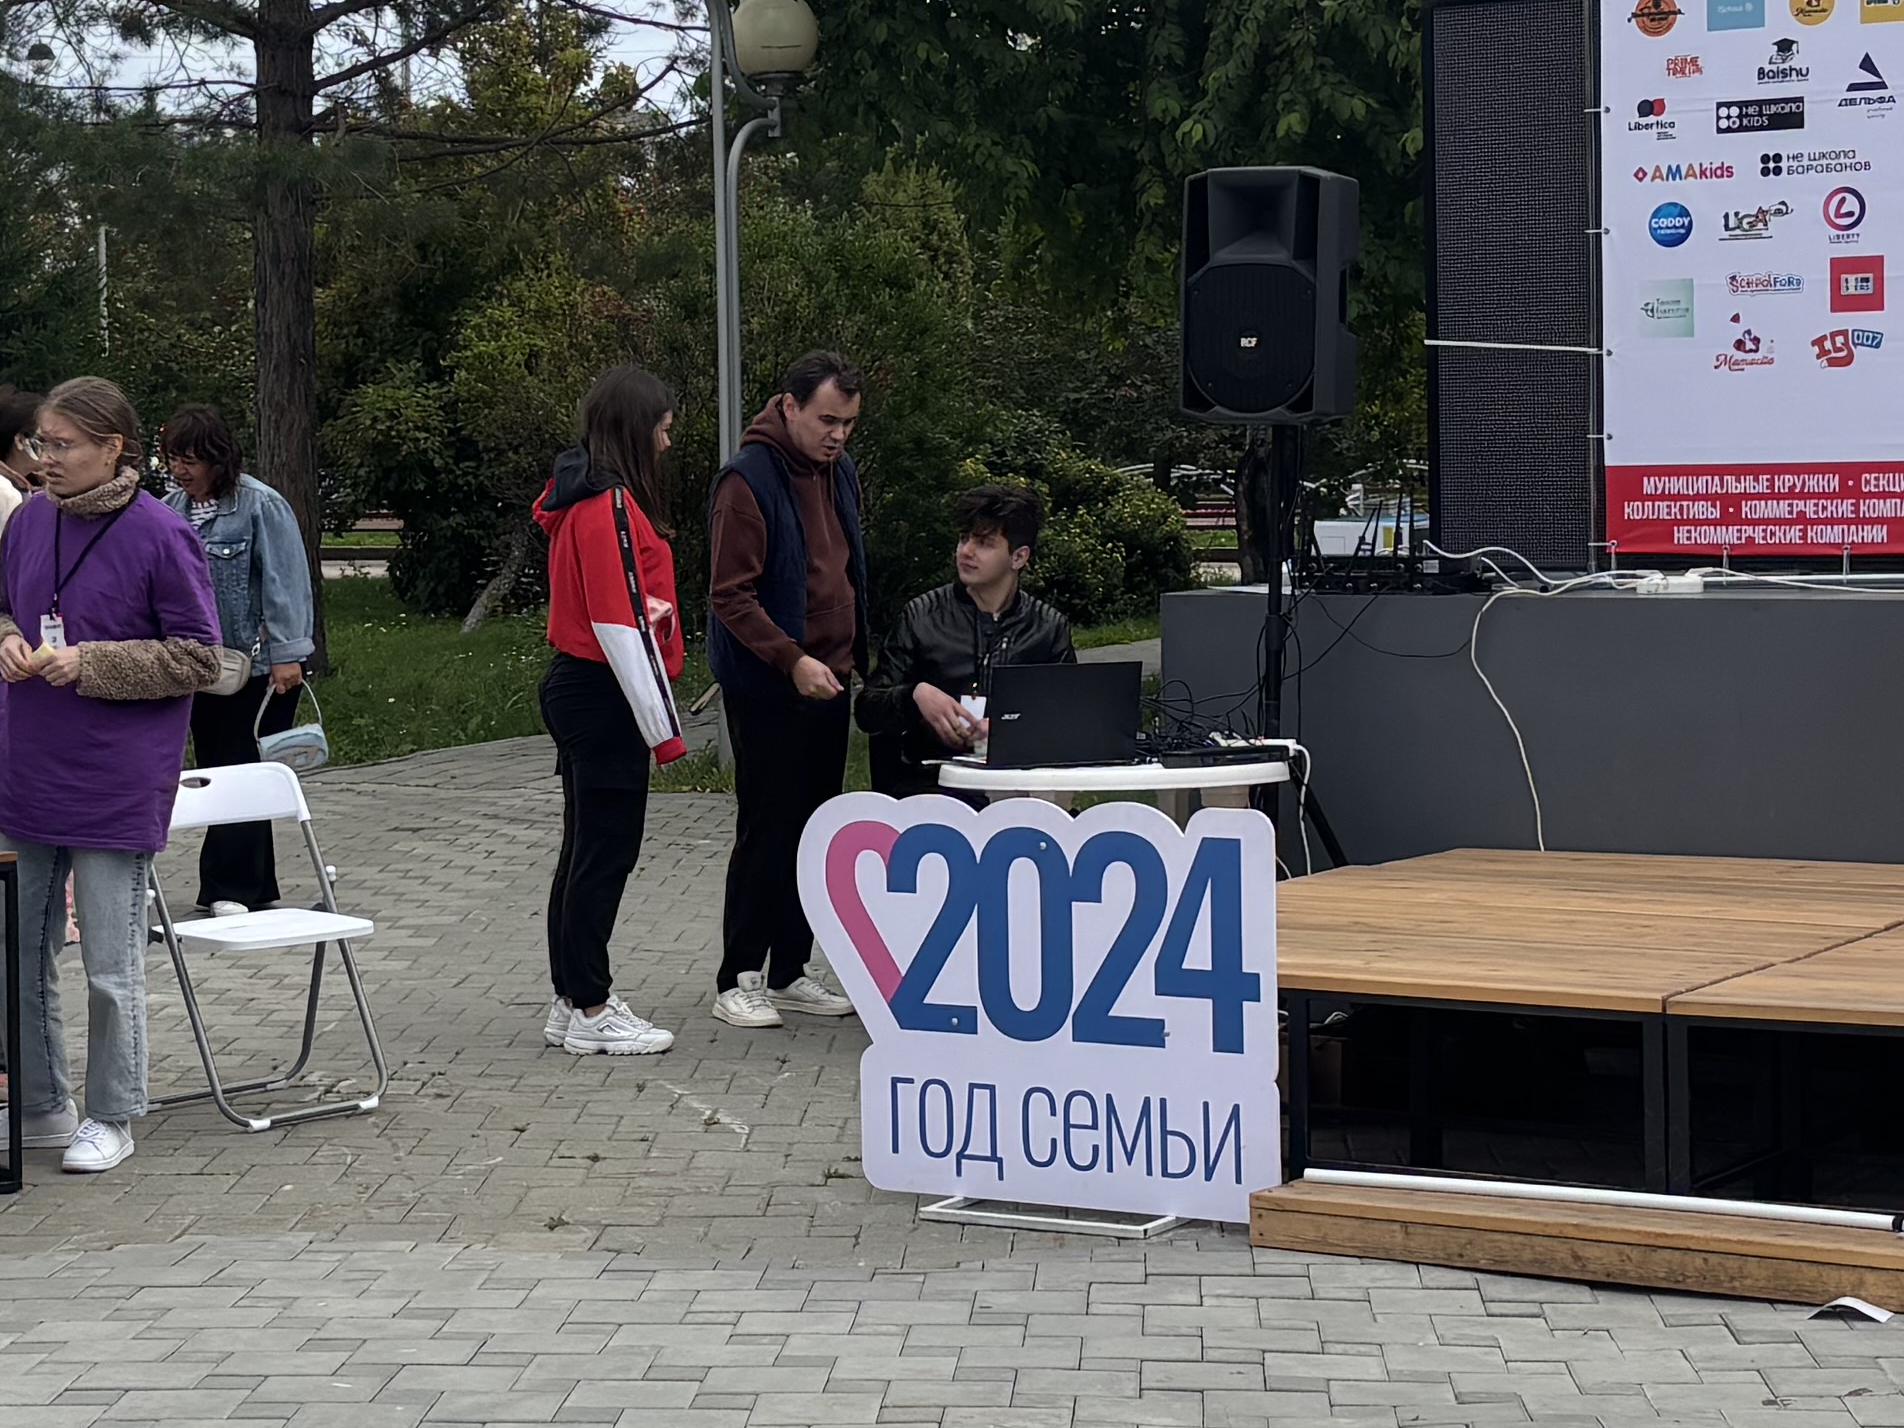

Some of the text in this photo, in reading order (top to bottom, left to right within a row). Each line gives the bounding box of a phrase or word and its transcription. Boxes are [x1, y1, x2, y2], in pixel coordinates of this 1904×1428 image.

[1742, 116, 1769, 127] KIDS
[1651, 216, 1691, 228] CODDY
[1854, 332, 1882, 347] 007
[1643, 475, 1771, 496] МУНИЦИПАЛЬНЫЕ
[1774, 474, 1839, 494] КРУЖКИ
[1624, 501, 1720, 520] КОЛЛЕКТИВЫ
[1741, 498, 1856, 520] КОММЕРЧЕСКИЕ
[1673, 524, 1888, 545] НЕКОММЕРЧЕСКИЕ КОМПАНИИ
[885, 822, 1262, 1055] 2024
